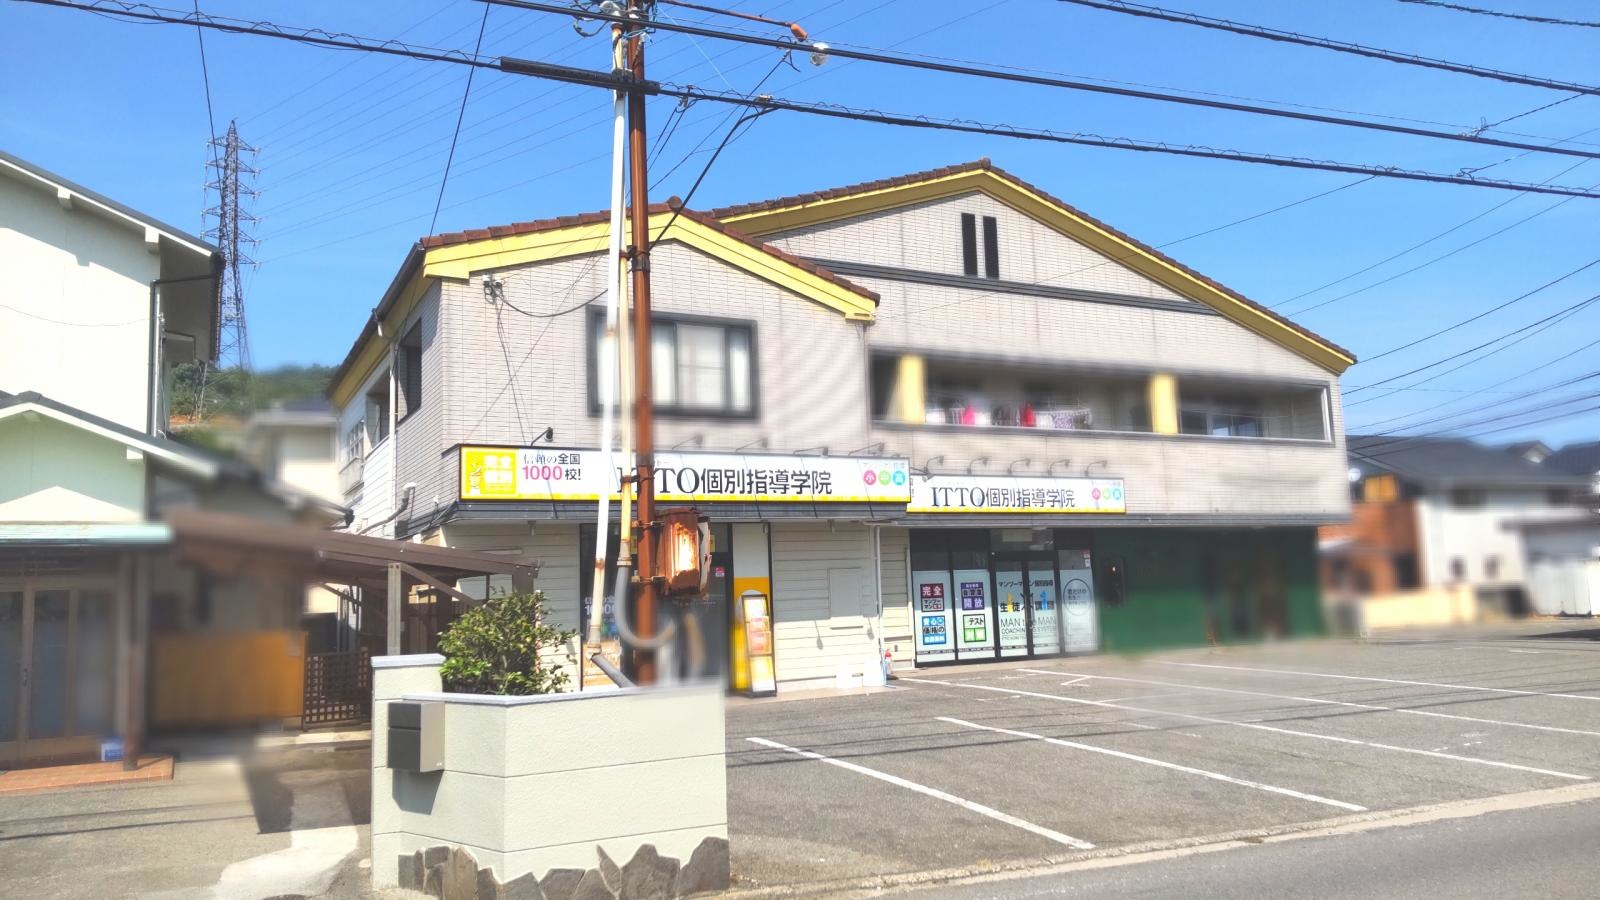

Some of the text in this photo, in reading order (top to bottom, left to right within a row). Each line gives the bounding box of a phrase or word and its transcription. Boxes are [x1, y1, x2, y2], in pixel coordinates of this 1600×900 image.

[522, 465, 581, 480] 1000校!
[931, 486, 1075, 508] ITTO個別指導学院
[922, 585, 941, 596] 完全
[969, 617, 984, 626] テスト
